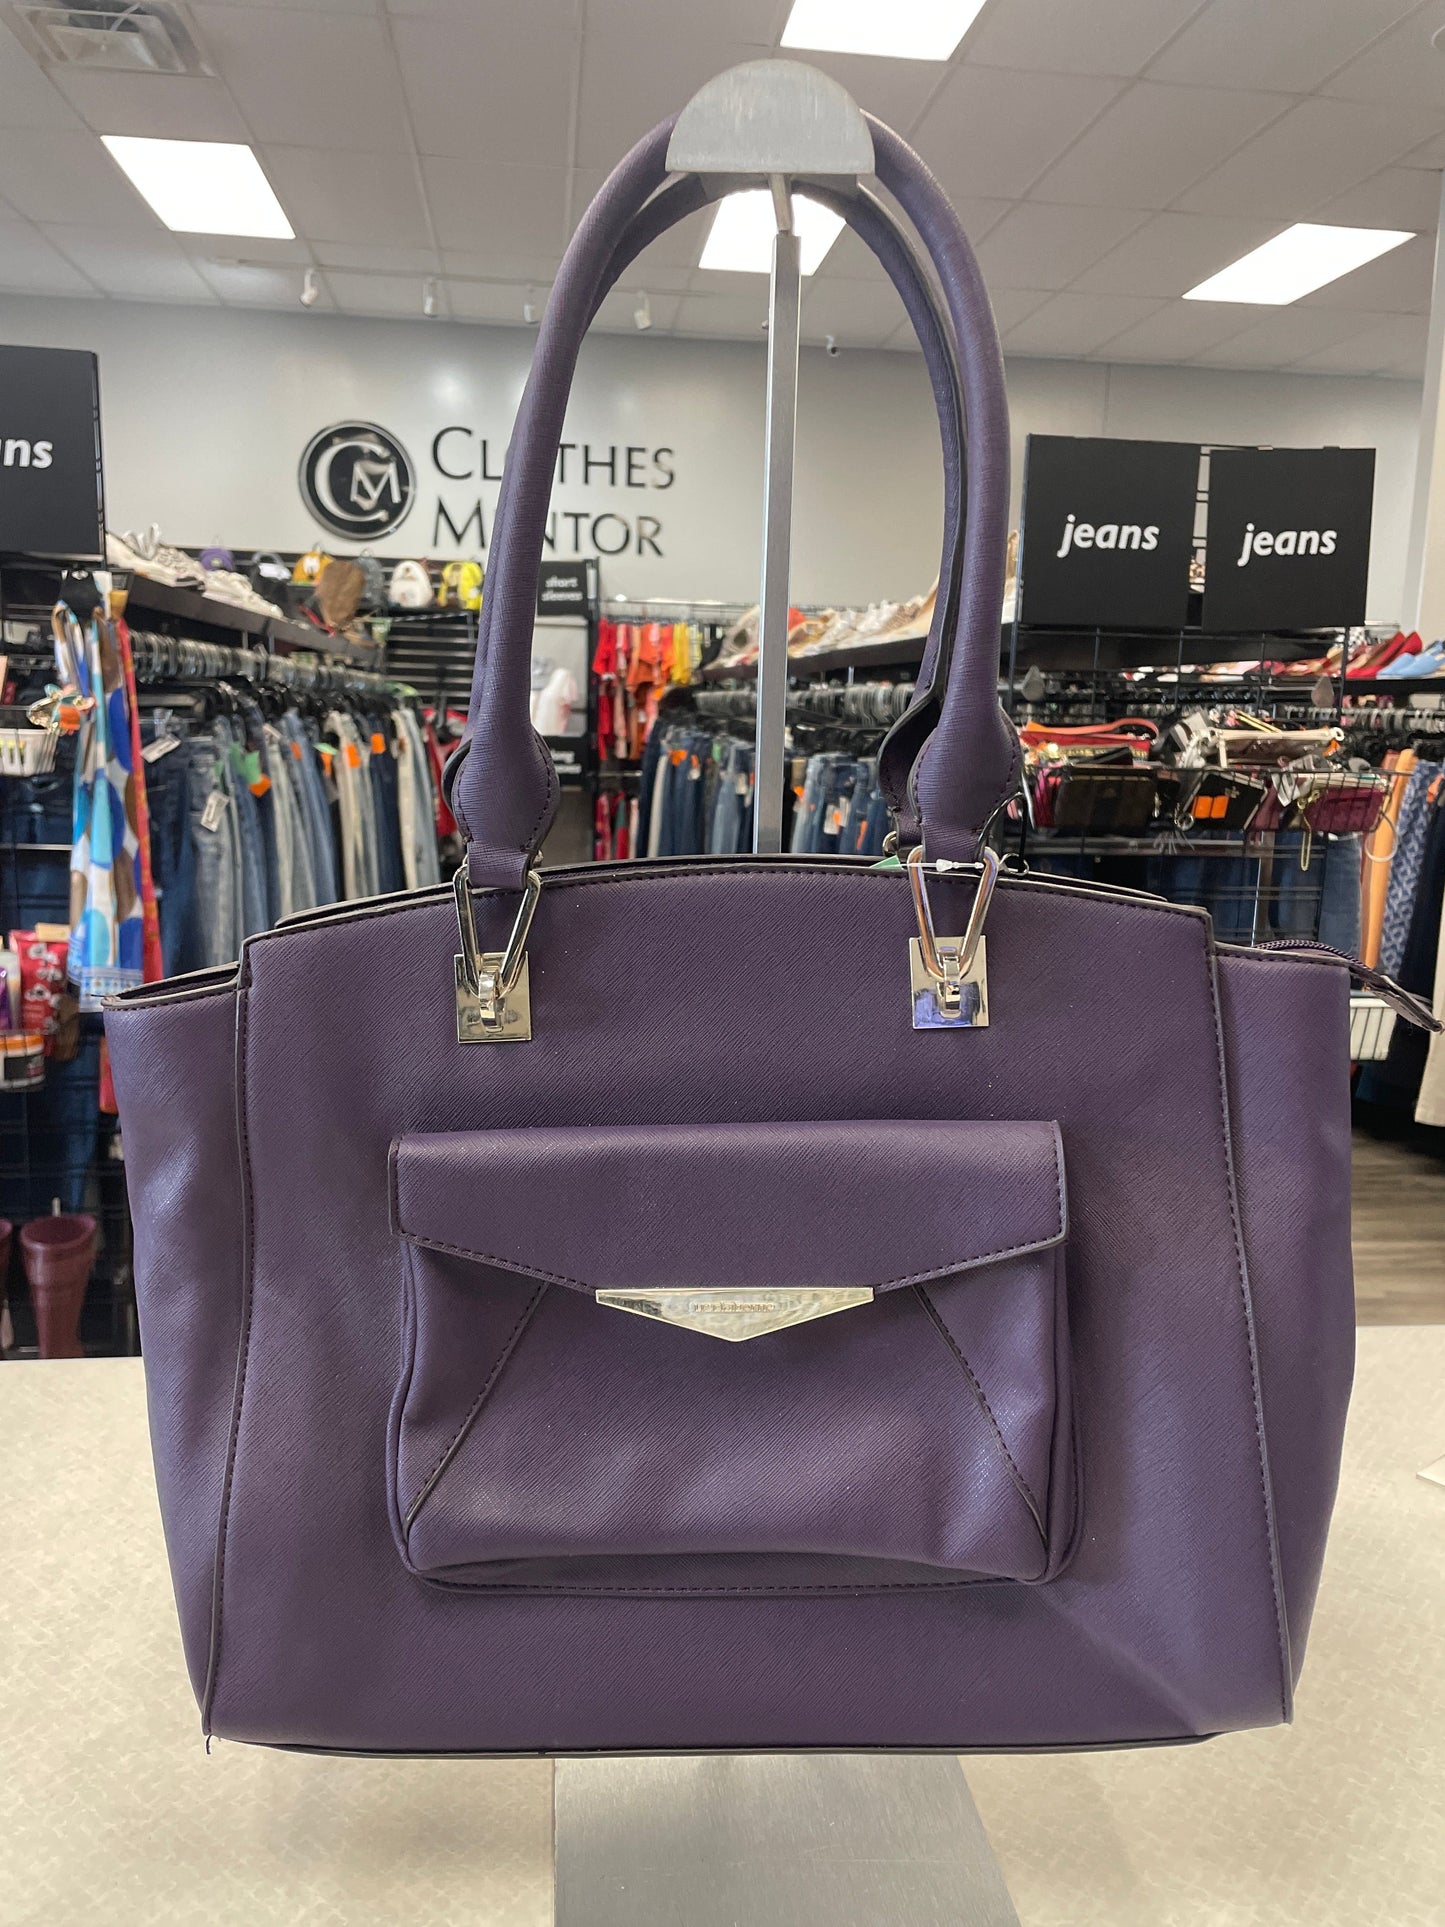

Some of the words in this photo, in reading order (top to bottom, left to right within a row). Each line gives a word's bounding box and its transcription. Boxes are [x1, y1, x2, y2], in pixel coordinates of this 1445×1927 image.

[0, 438, 53, 469] ns
[432, 426, 676, 490] CLTHES
[433, 497, 664, 557] MTOR
[1057, 514, 1160, 558] jeans
[1237, 523, 1338, 567] jeans
